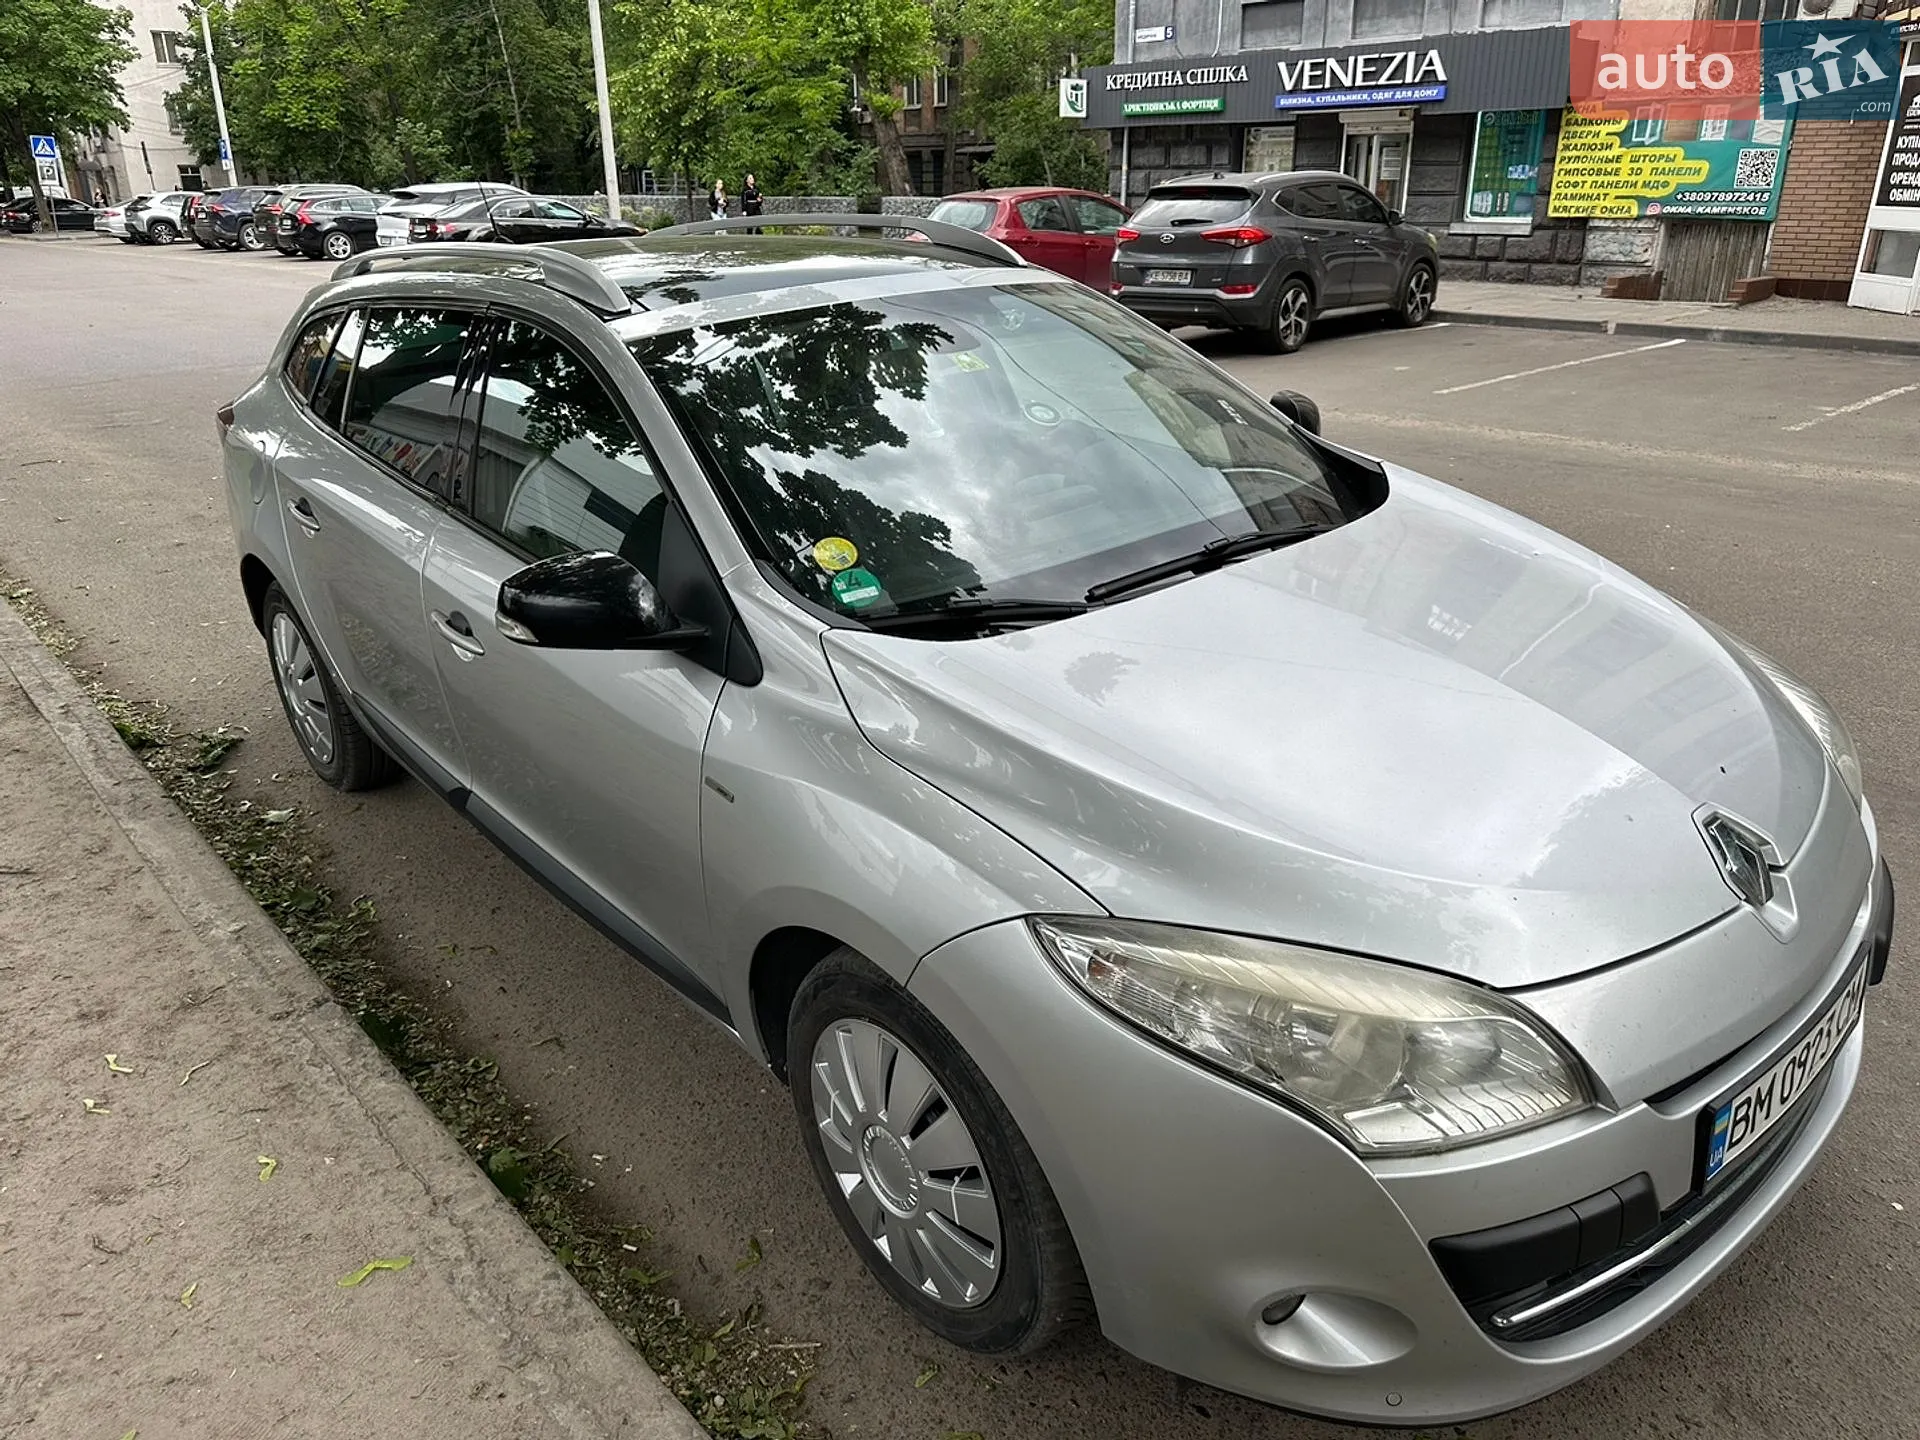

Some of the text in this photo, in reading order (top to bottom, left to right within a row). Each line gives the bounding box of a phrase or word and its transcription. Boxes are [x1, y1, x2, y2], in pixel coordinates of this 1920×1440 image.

[1166, 26, 1174, 39] 5
[1277, 49, 1448, 92] VENEZIA
[1106, 65, 1249, 92] КРЕДИТНА СПІЛКА
[1372, 91, 1393, 101] ОДЯГ
[1395, 90, 1412, 99] ДЛЯ
[1413, 89, 1438, 99] ДОМУ
[1565, 117, 1622, 127] БАЛКОНЫ
[1562, 130, 1600, 140] ДВЕРИ
[1561, 142, 1613, 152] ЖАЛЮЗИ
[1896, 135, 1920, 149] КУПІ
[1559, 154, 1677, 164] РУЛОННЫЕ ШТОРЫ
[1558, 167, 1702, 177] ГИПСОВЫЕ 3D ПАНЕЛИ
[1556, 180, 1670, 190] СОФТ ПАНЕЛИ МДФ
[1553, 193, 1609, 201] ЛАМИНАТ
[1676, 192, 1770, 202] +380978972415
[1552, 205, 1632, 214] МЯГКИЕ ОКНА
[1727, 1072, 1777, 1152] BM
